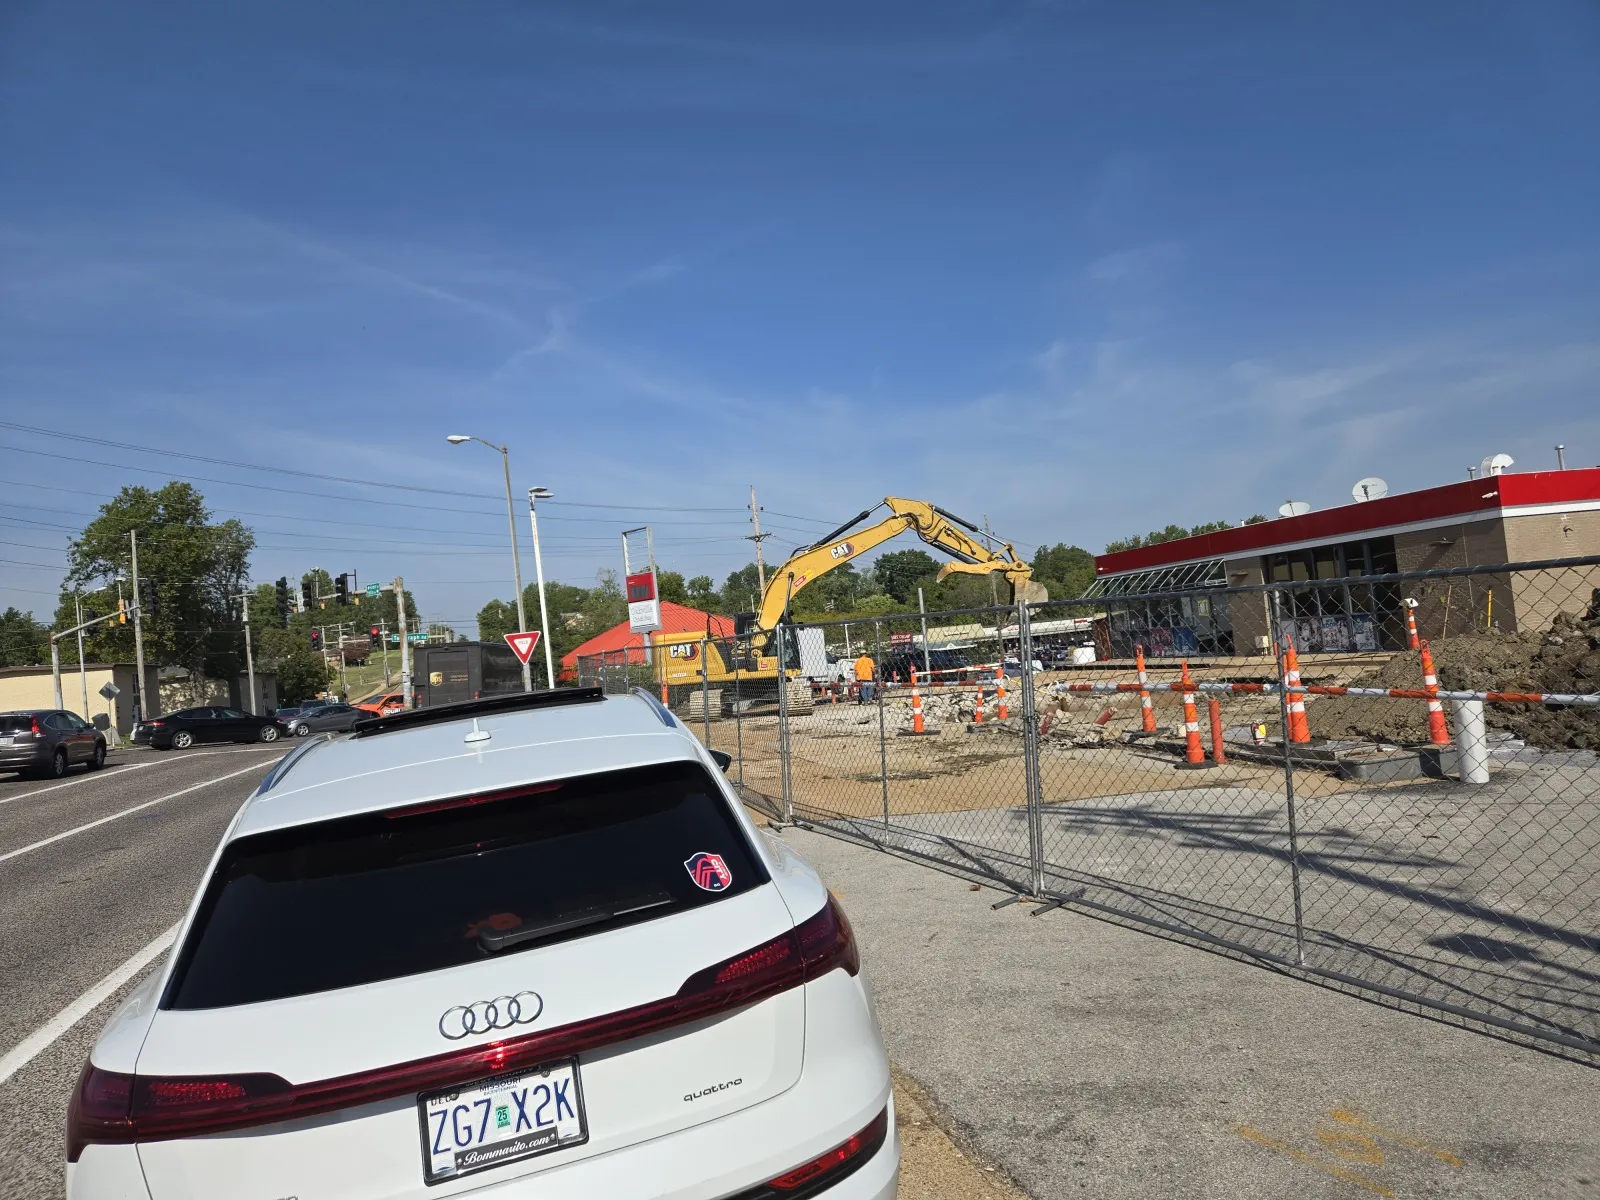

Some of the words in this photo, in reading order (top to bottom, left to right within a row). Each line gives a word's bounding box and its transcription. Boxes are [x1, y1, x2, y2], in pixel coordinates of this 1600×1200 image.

[830, 543, 849, 559] CAT
[393, 634, 420, 642] Teraph
[669, 643, 692, 658] CAT
[711, 859, 727, 880] CITY
[479, 1077, 521, 1093] MISSOURI
[683, 1078, 743, 1102] quattro
[430, 1098, 492, 1156] ZG7
[511, 1077, 575, 1133] X2K
[497, 1109, 508, 1121] 25
[463, 1135, 550, 1166] Bommarito.com
